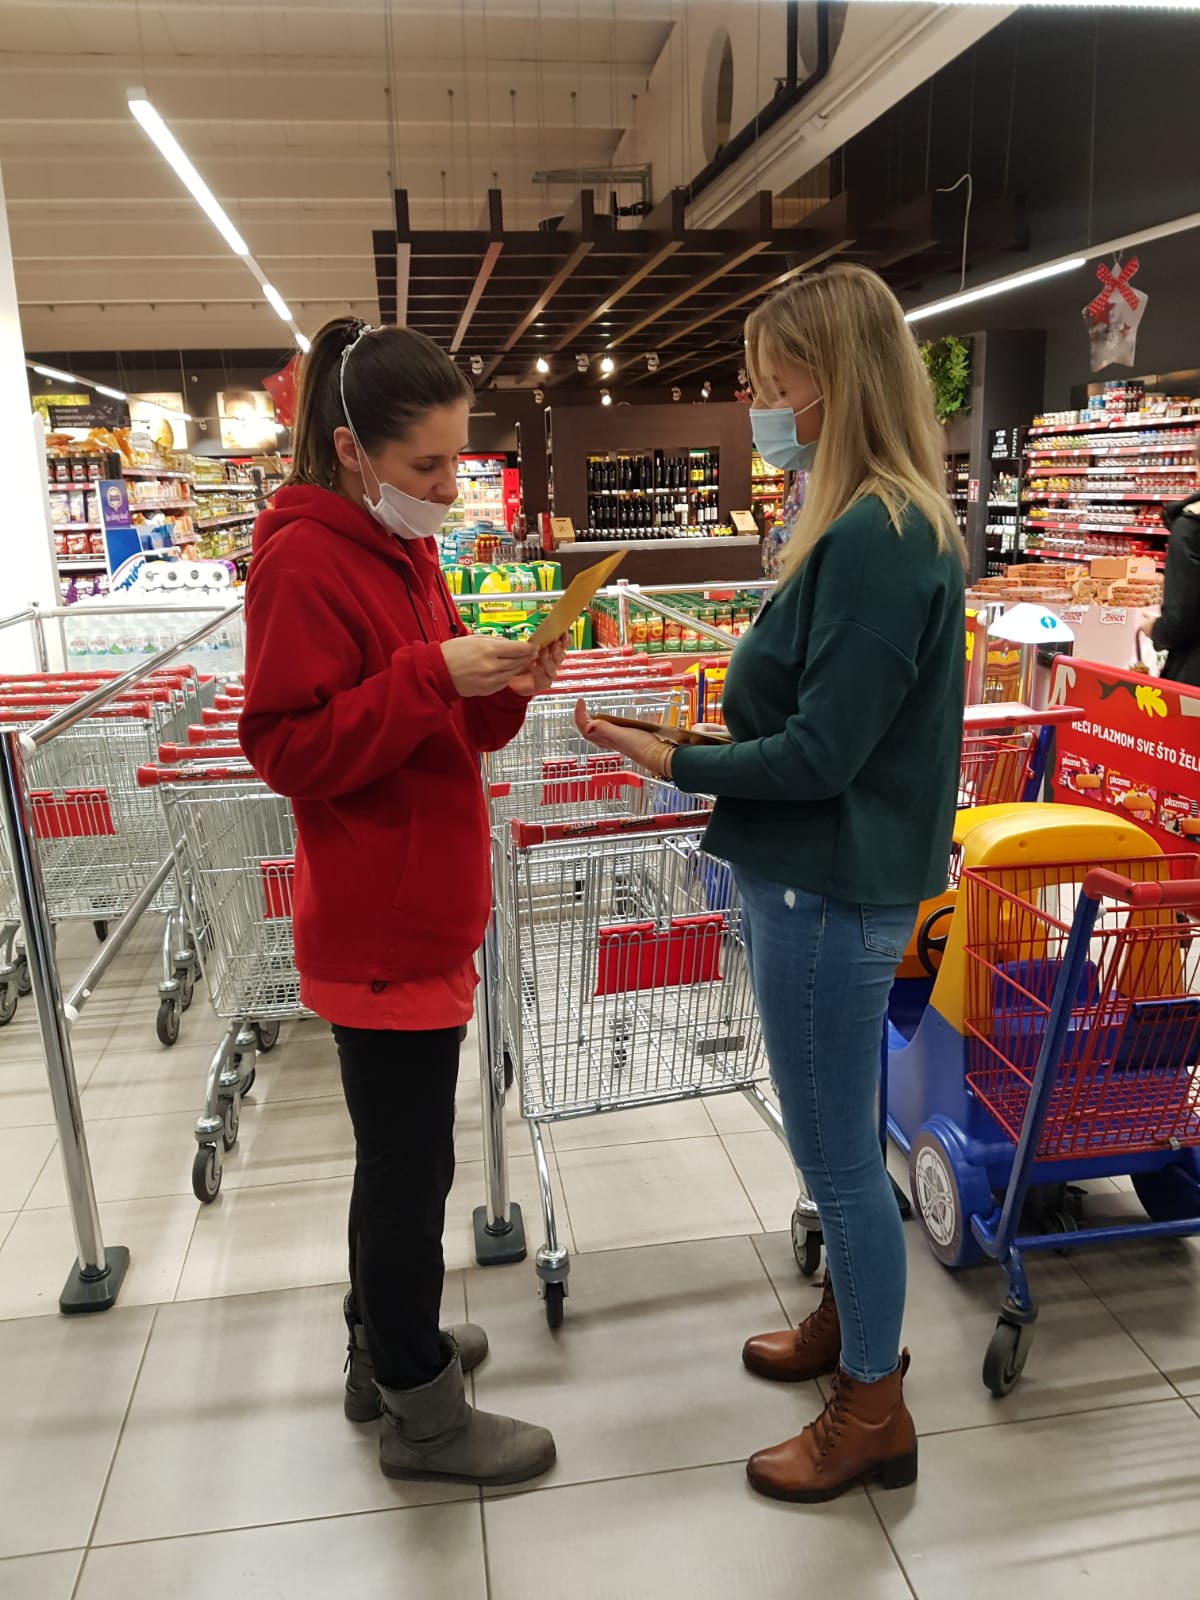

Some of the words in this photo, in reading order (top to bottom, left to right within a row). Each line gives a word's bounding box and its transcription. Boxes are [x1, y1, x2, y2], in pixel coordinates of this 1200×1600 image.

[1092, 723, 1135, 749] PLAZMOM
[1136, 738, 1155, 757] SVE
[1156, 741, 1177, 764] ŠTO
[1164, 797, 1189, 810] plazma
